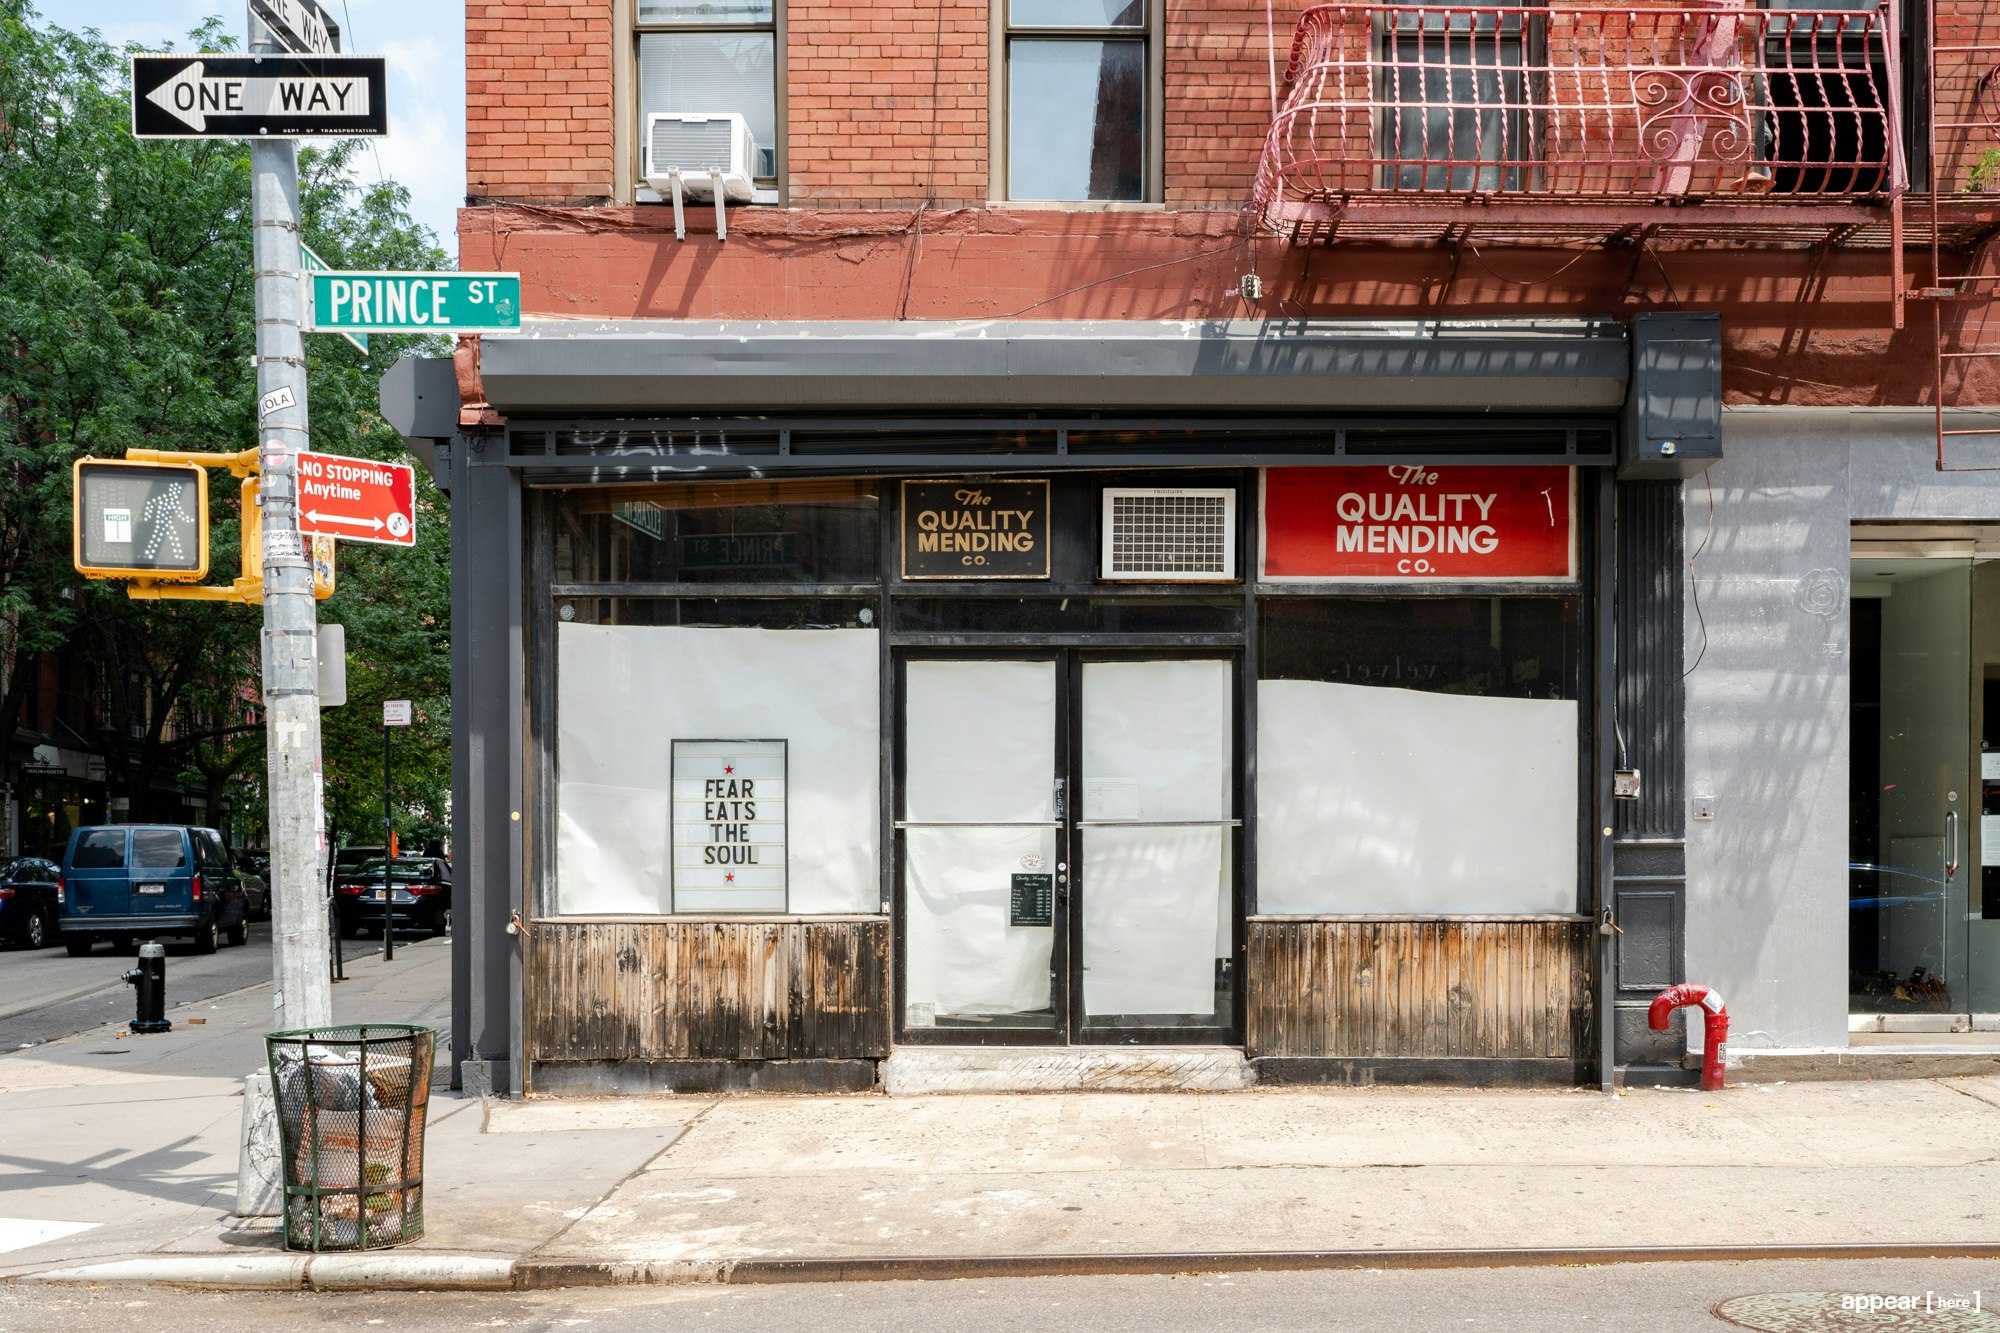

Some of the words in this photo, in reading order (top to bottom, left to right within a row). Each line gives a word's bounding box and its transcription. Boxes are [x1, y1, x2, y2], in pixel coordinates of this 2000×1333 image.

[174, 82, 243, 111] ONE
[280, 82, 353, 111] WAY
[330, 279, 450, 324] PRINCE
[468, 281, 498, 304] ST
[302, 460, 323, 477] NO
[326, 464, 393, 487] STOPPING
[1388, 465, 1439, 485] The
[303, 479, 361, 500] Anytime
[954, 488, 992, 506] The
[1336, 492, 1498, 523] QUALITY
[917, 510, 1034, 532] QUALITY
[918, 531, 1035, 552] MENDING
[1336, 524, 1499, 554] MENDING
[961, 555, 990, 566] CO.
[1397, 559, 1436, 574] CO.
[705, 779, 754, 799] FEAR
[705, 801, 756, 821] EATS
[711, 823, 750, 842] THE
[704, 845, 758, 865] SOUL
